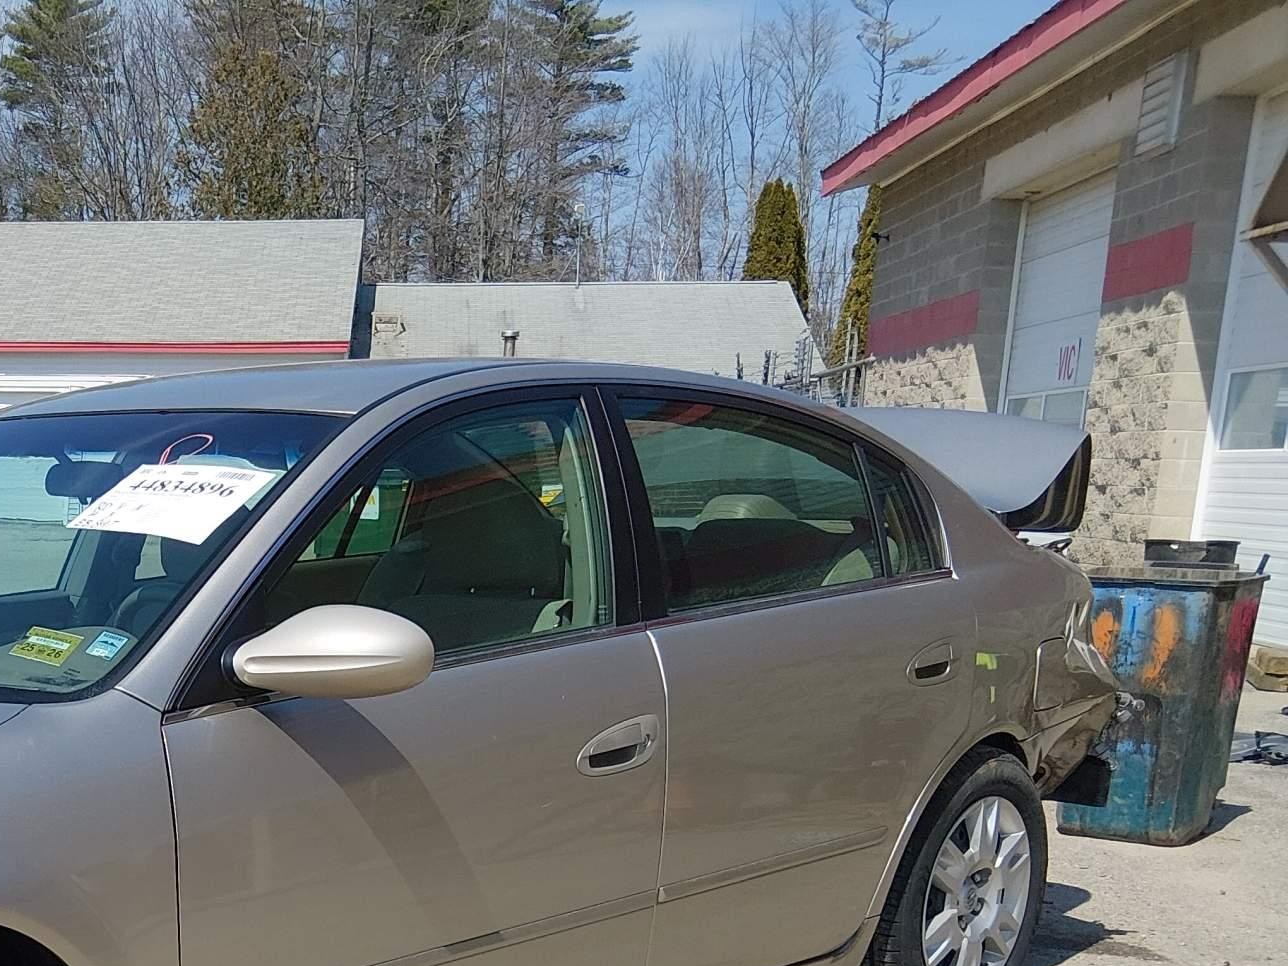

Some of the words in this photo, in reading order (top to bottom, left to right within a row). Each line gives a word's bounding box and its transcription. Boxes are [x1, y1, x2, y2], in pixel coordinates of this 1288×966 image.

[129, 479, 239, 497] 44834896
[20, 642, 36, 652] 25
[46, 648, 63, 659] 26
